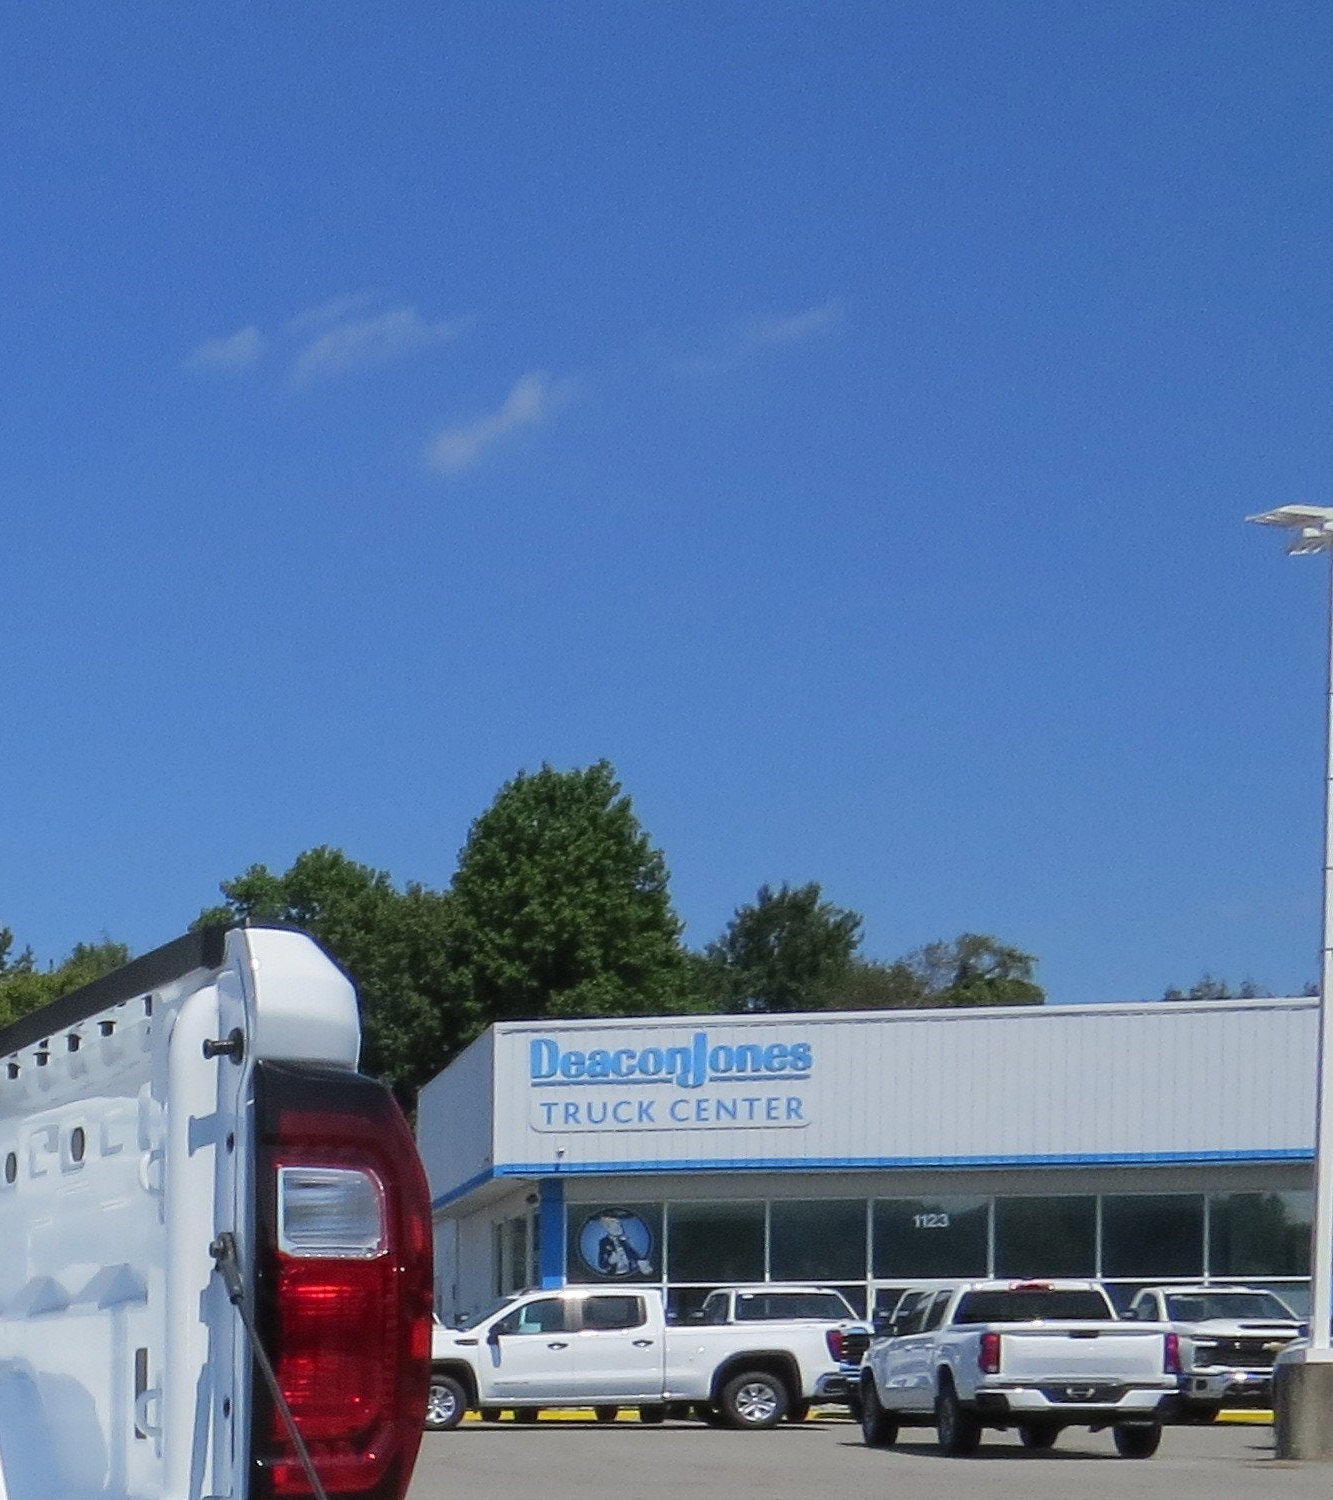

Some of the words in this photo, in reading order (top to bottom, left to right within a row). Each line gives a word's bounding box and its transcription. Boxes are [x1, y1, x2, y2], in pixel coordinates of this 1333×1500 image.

[539, 1101, 656, 1125] TRUCK
[669, 1096, 804, 1122] CENTER
[913, 1213, 949, 1228] 1123
